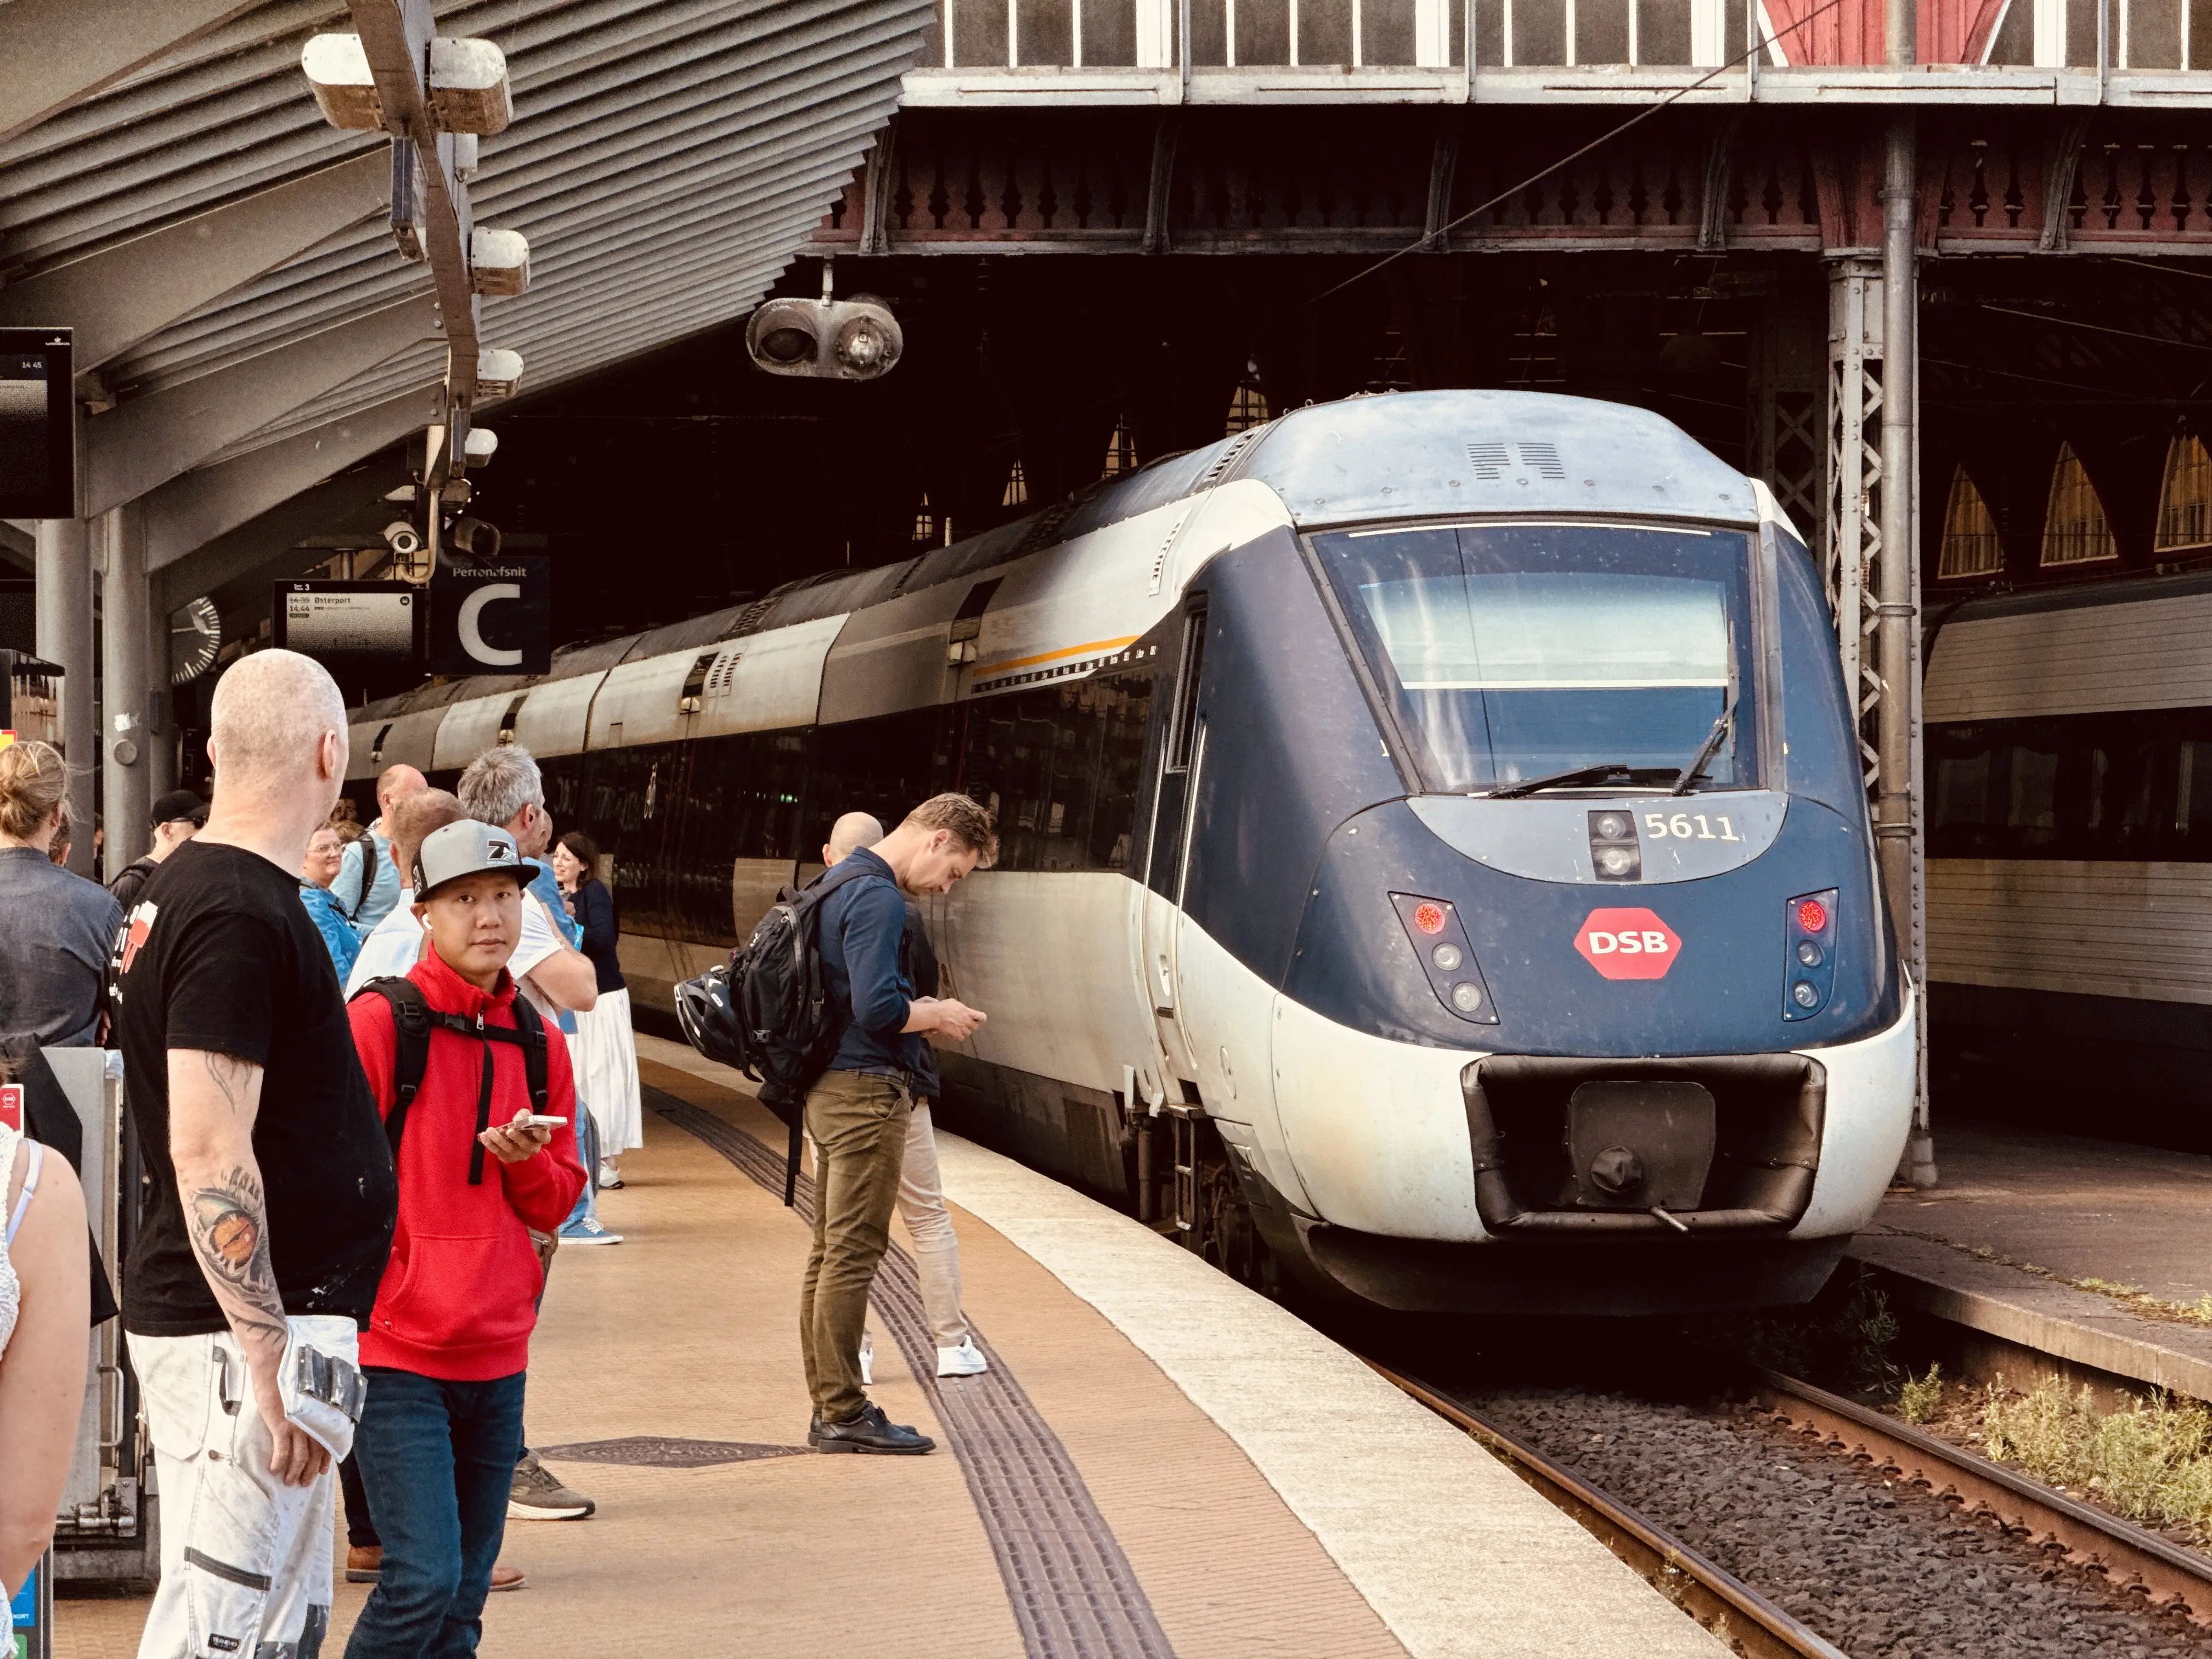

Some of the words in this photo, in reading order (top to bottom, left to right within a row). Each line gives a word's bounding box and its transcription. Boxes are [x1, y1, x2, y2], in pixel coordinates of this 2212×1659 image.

[458, 583, 522, 666] C
[1645, 814, 1740, 841] 5611
[1588, 931, 1668, 954] DSB
